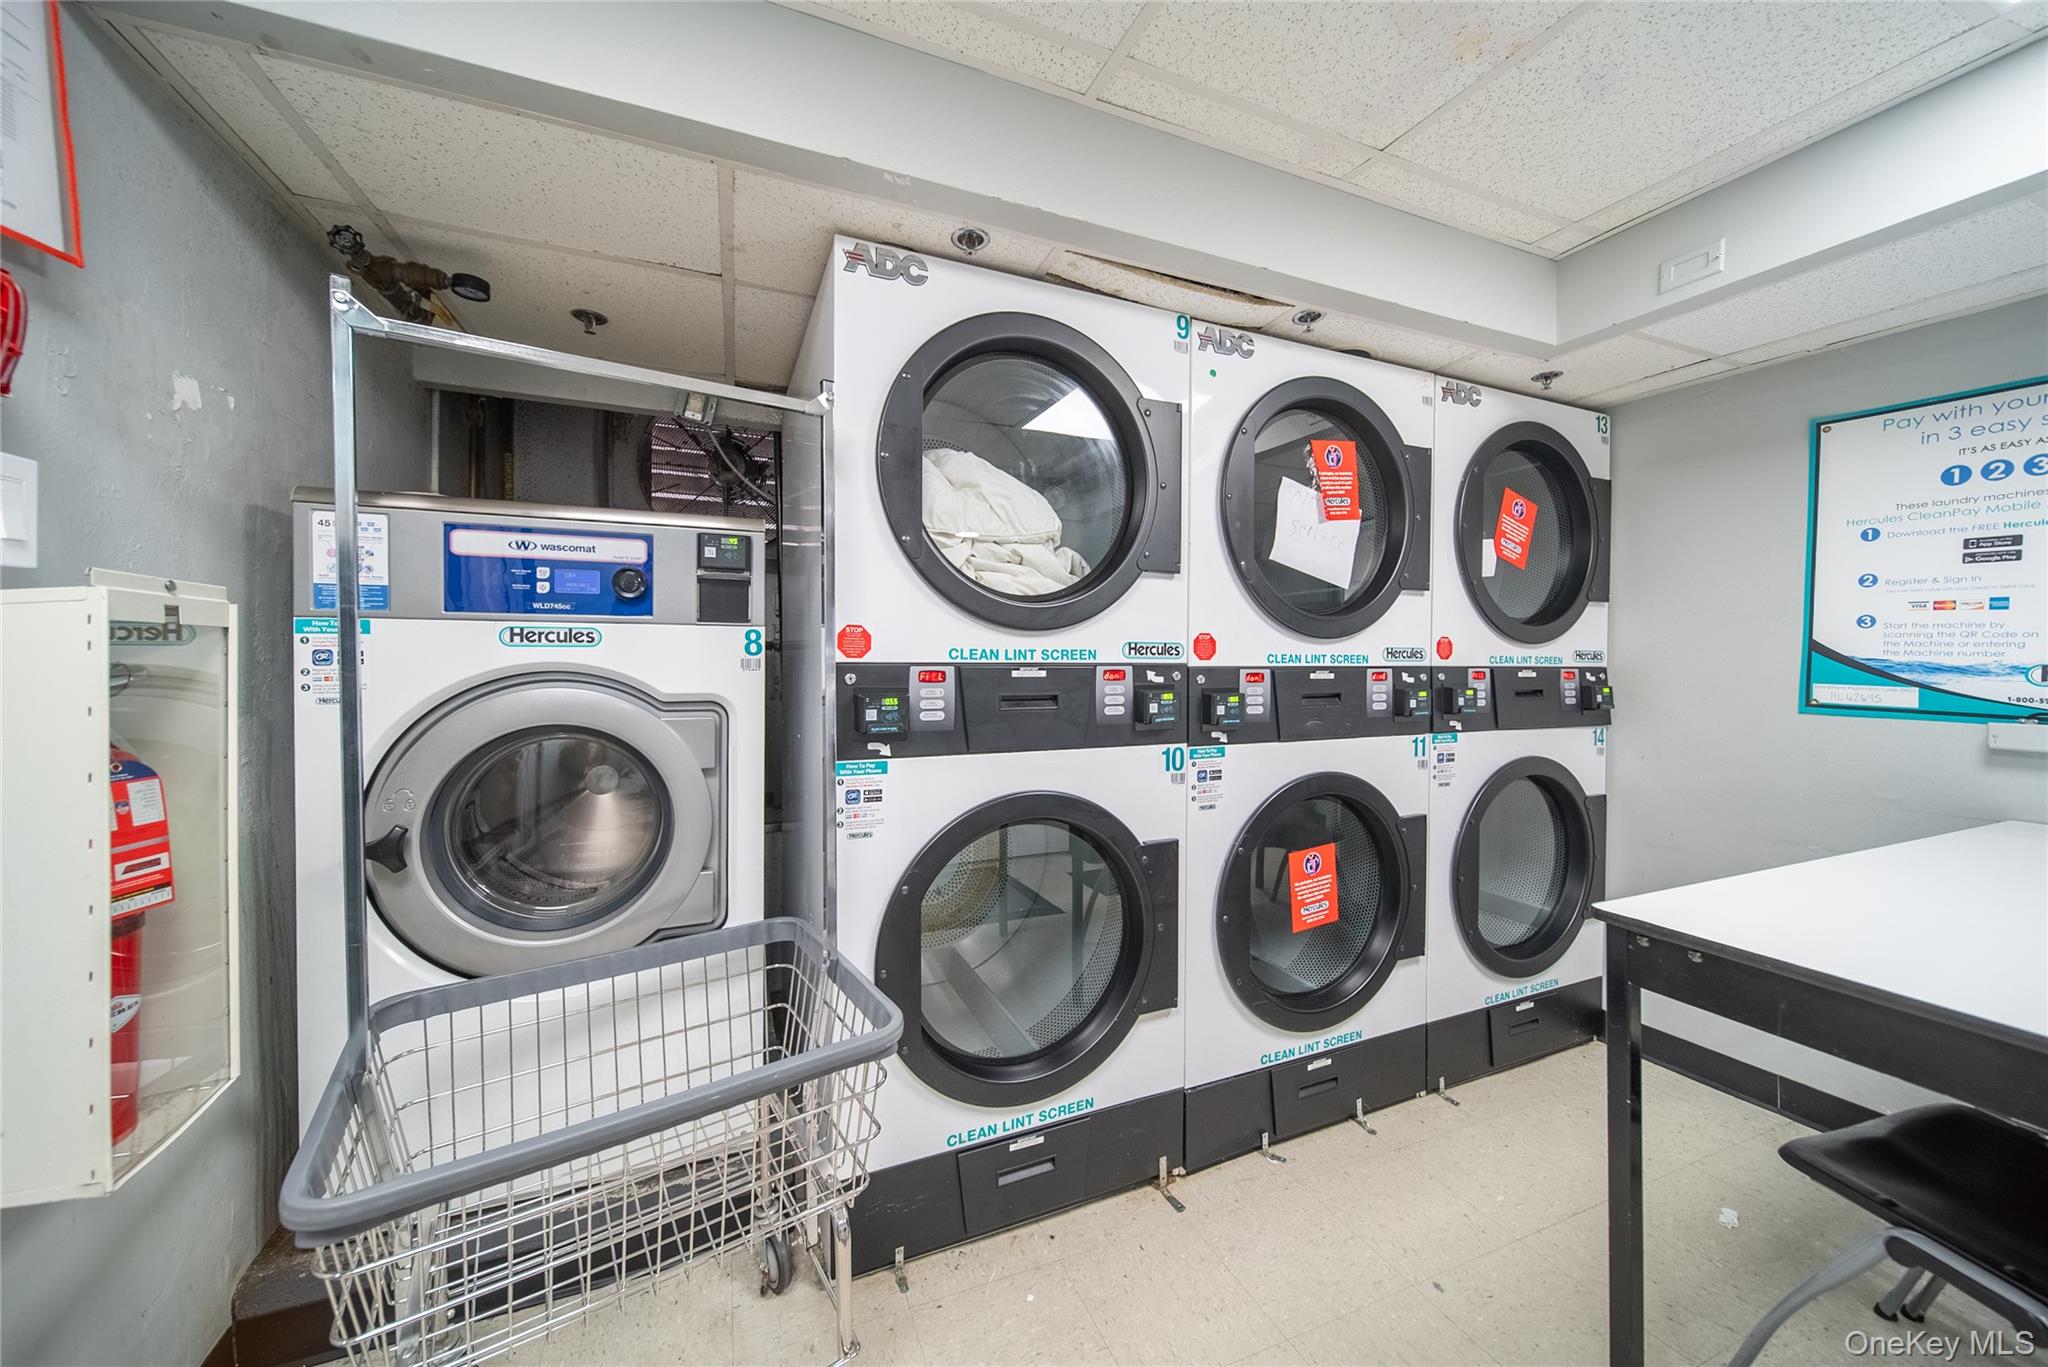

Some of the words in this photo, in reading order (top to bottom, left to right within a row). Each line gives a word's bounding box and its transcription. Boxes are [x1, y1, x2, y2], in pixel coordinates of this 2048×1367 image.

[843, 242, 928, 287] ADC
[1176, 314, 1190, 340] 9
[1197, 326, 1255, 359] ADC
[1441, 380, 1482, 407] ADC
[1595, 414, 1608, 434] 13
[1883, 415, 1925, 432] Pay
[1932, 404, 1983, 423] with
[1920, 431, 1940, 445] in
[1948, 426, 1962, 441] 3
[1970, 416, 2032, 437] easy
[1958, 446, 1978, 456] IT'S
[1980, 444, 1997, 453] AS
[2000, 438, 2032, 450] EASY
[1949, 468, 1962, 484] 1
[1988, 461, 2006, 480] 2
[1896, 501, 1928, 511] These
[1932, 494, 1980, 508] laundry
[1846, 514, 1904, 527] Hercules
[1907, 506, 1981, 522] CleanPay
[1985, 500, 2042, 514] Mobile
[1887, 528, 1946, 540] Download
[1949, 525, 1968, 534] the
[1971, 522, 2000, 532] FREE
[540, 543, 596, 554] wascomat
[1884, 577, 1928, 587] Register
[1943, 575, 1968, 586] Sign
[1990, 622, 2006, 630] by
[508, 627, 596, 644] Hercules
[744, 628, 763, 656] 8
[1883, 631, 1934, 640] scanning
[1972, 640, 2026, 649] entering
[948, 648, 1000, 661] CLEAN
[1004, 648, 1036, 661] LINT
[1040, 649, 1098, 661] SCREEN
[1128, 642, 1180, 656] Hercules
[1386, 648, 1424, 660] Hercules
[1575, 650, 1603, 661] Hercules
[1266, 654, 1302, 664] CLEAN
[1304, 654, 1328, 664] LINT
[1330, 654, 1369, 664] SCREEN
[1489, 656, 1514, 664] CLEAN
[1516, 656, 1534, 664] LINT
[1535, 656, 1563, 665] SCREEN
[1592, 728, 1605, 746] 14
[1412, 736, 1426, 757] 11
[1162, 747, 1184, 772] 10
[1484, 992, 1510, 1006] CLEAN
[1512, 986, 1528, 998] LINT
[1530, 978, 1560, 993] SCREEN
[1260, 1047, 1296, 1065] CLEAN
[1298, 1040, 1320, 1055] LINT
[1323, 1030, 1362, 1048] SCREEN
[946, 1124, 998, 1148] CLEAN
[1002, 1113, 1034, 1132] LINT
[1038, 1098, 1094, 1122] SCREEN
